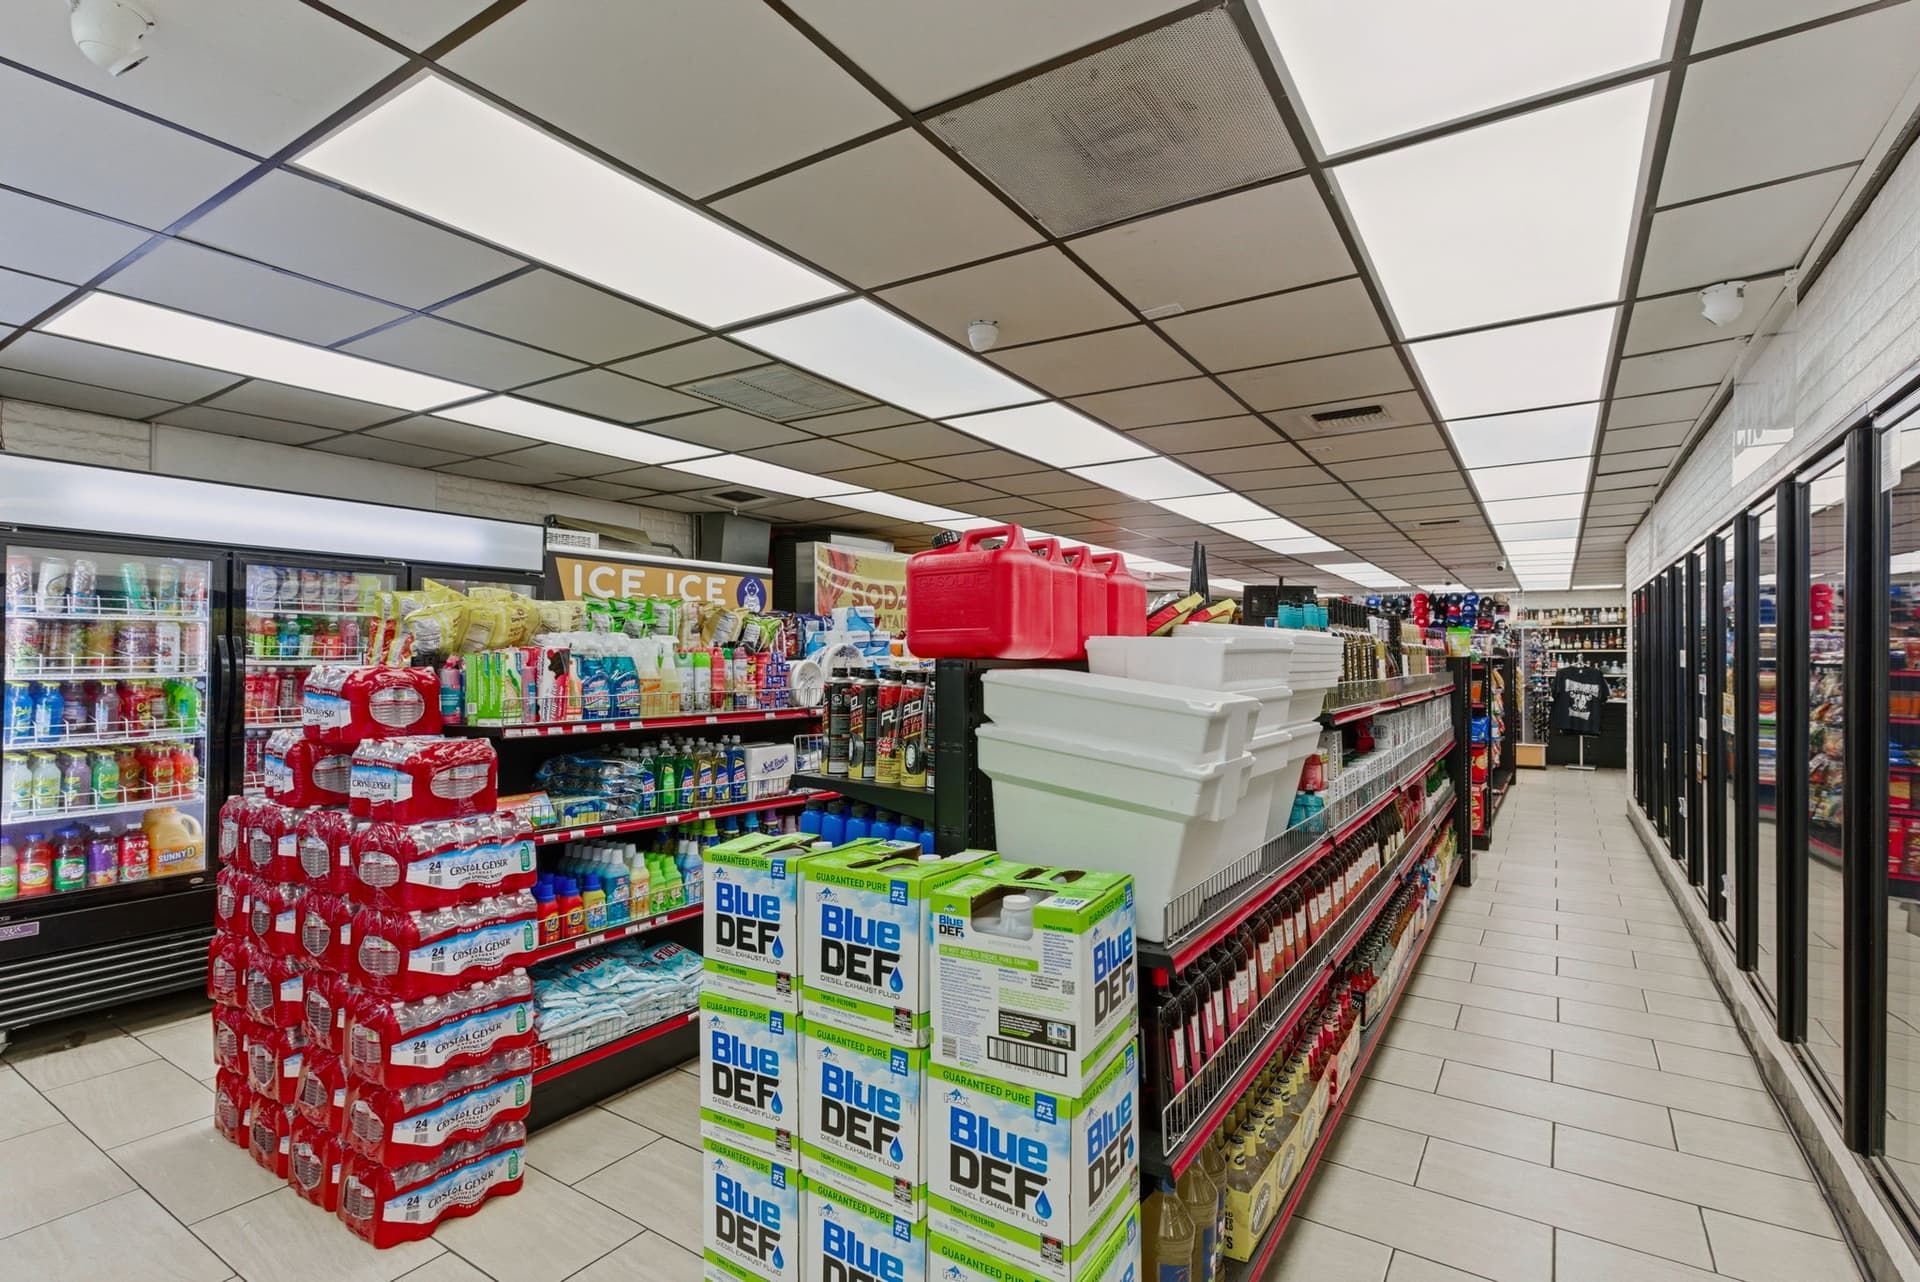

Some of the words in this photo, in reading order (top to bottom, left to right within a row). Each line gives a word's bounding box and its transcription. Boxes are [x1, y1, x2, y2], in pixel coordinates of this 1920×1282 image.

[574, 564, 647, 599] ICE
[666, 573, 727, 606] ICE
[429, 861, 442, 871] 24
[450, 865, 480, 876] CRYSTAL
[482, 858, 508, 870] GEYSER
[712, 853, 750, 868] GUARANTEED
[750, 858, 769, 869] PURE
[716, 882, 781, 921] Blue
[815, 872, 865, 889] GUARANTEED
[866, 880, 887, 893] PURE
[716, 913, 780, 955] DEF
[821, 903, 900, 951] Blue
[939, 914, 964, 927] Blue
[939, 924, 963, 937] DEF
[432, 947, 445, 957] 24
[453, 945, 483, 961] CRYSTAL
[485, 938, 511, 951] GEYSER
[821, 938, 900, 987] DEF
[1093, 926, 1133, 984] Blue
[820, 974, 844, 986] DIESEL
[844, 978, 877, 994] EXHAUST
[878, 989, 900, 1000] FLUID
[1094, 956, 1133, 1027] DEF
[706, 1001, 748, 1019] GUARANTEED
[748, 1010, 767, 1022] PURE
[414, 1040, 426, 1051] 24
[435, 1035, 469, 1054] CRYSTAL
[472, 1022, 502, 1040] GEYSER
[712, 1030, 779, 1077] Blue
[816, 1029, 865, 1051] GUARANTEED
[866, 1044, 887, 1060] PURE
[712, 1061, 779, 1110] DEF
[822, 1061, 900, 1121] Blue
[943, 1071, 1002, 1096] GUARANTEED
[1004, 1089, 1031, 1106] PURE
[415, 1119, 428, 1129] 24
[436, 1109, 471, 1132] CRYSTAL
[472, 1095, 502, 1116] GEYSER
[821, 1096, 900, 1154] DEF
[1088, 1091, 1132, 1164] Blue
[711, 1142, 751, 1165] GUARANTEED
[752, 1160, 769, 1174] PURE
[951, 1106, 1048, 1174] Blue
[950, 1143, 1048, 1210] DEF
[1088, 1119, 1132, 1207] DEF
[407, 1195, 420, 1207] 24
[428, 1186, 463, 1209] CRYSTAL
[464, 1170, 495, 1190] GEYSER
[716, 1173, 781, 1231] Blue
[817, 1186, 868, 1216] GUARANTEED
[868, 1207, 891, 1224] PURE
[949, 1184, 979, 1200] DIESEL
[979, 1192, 1020, 1218] EXHAUST
[1021, 1209, 1048, 1228] FLUID
[716, 1205, 781, 1262] DEF
[823, 1219, 904, 1282] Blue
[942, 1246, 1003, 1280] GUARANTEED
